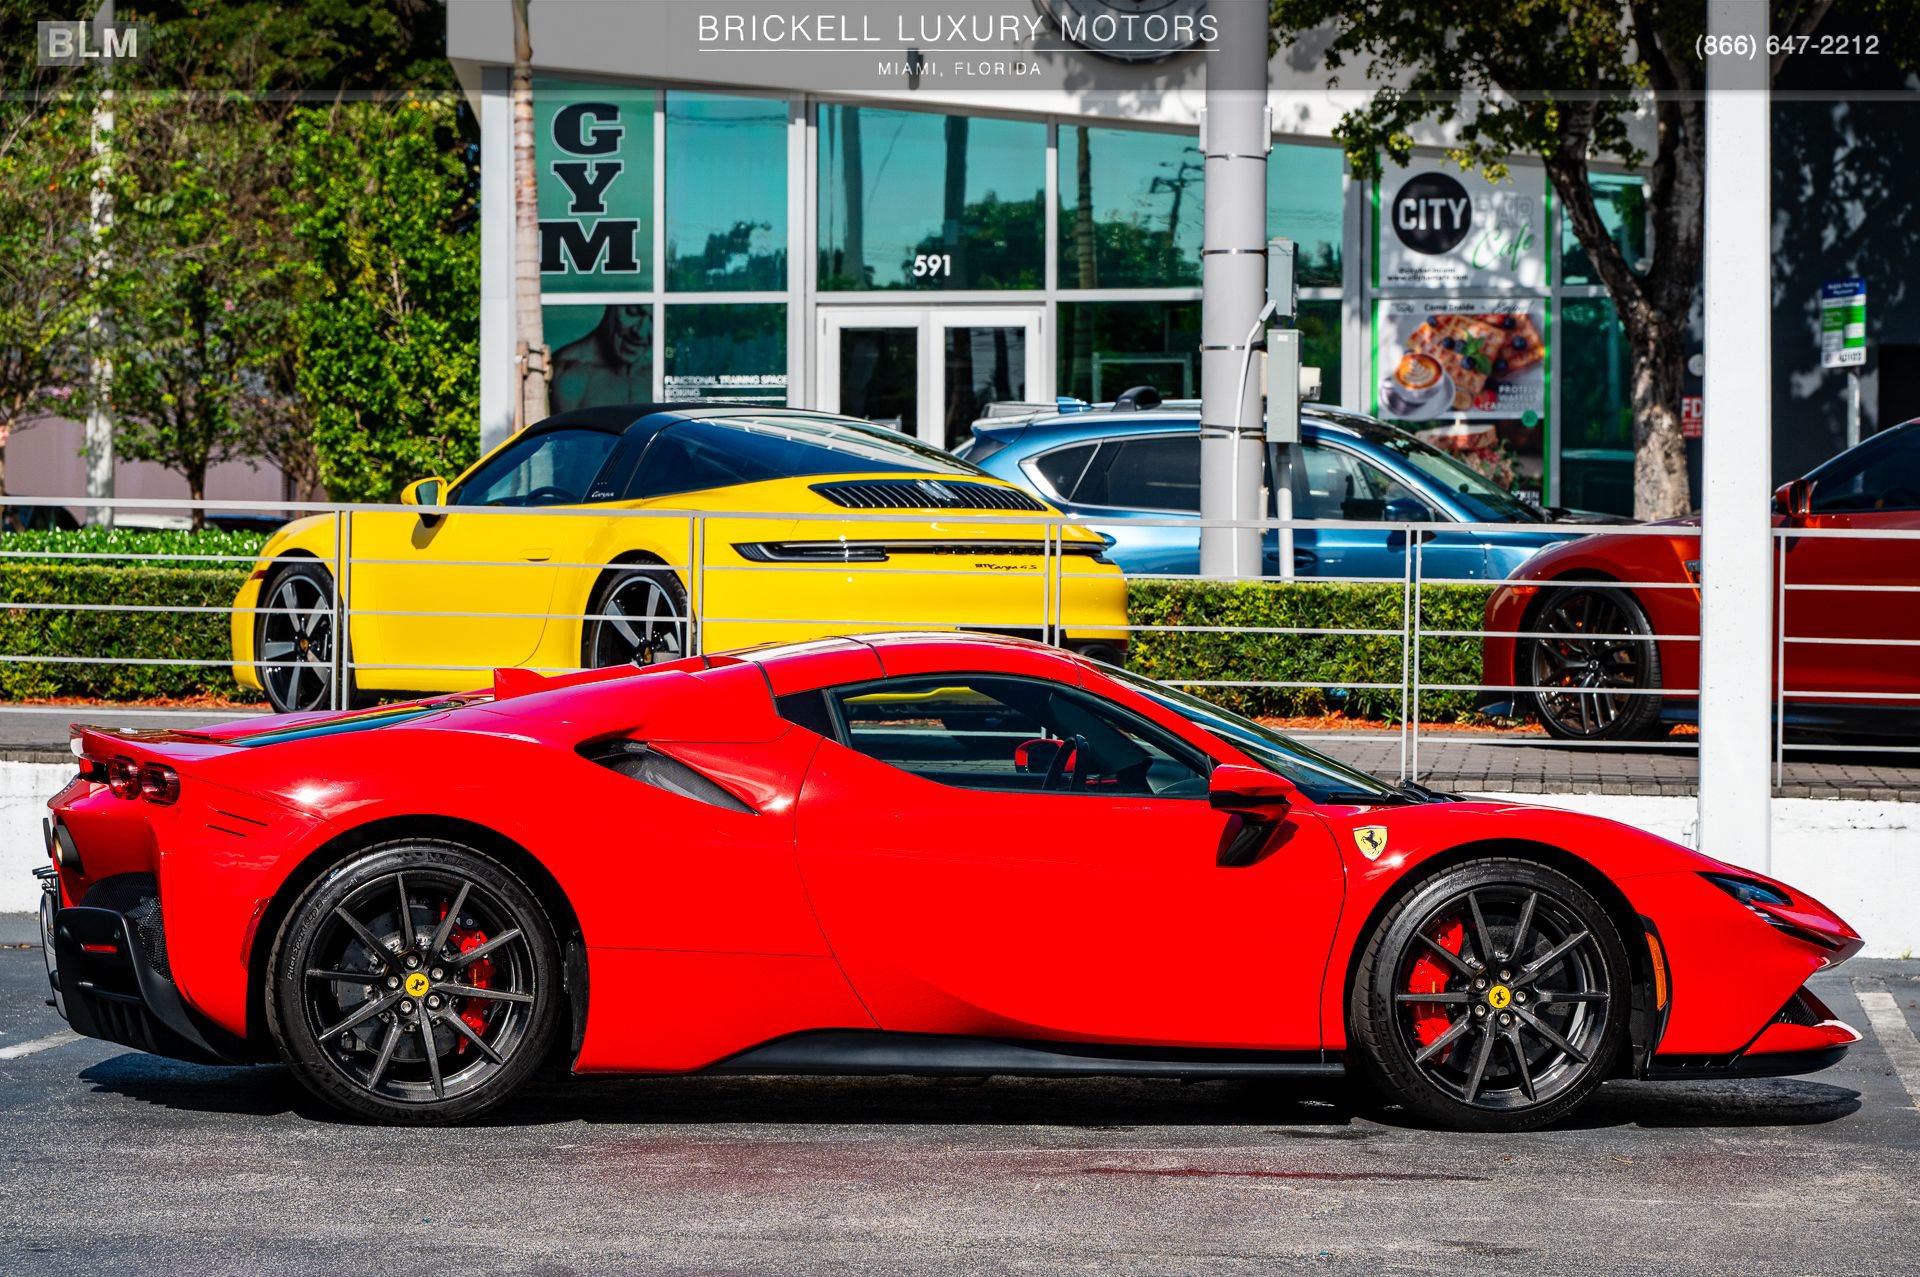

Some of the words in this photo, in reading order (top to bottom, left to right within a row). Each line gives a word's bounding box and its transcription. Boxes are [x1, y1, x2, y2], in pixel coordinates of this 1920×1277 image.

[539, 102, 641, 275] GYM
[1399, 198, 1468, 230] CITY
[912, 254, 951, 277] 591
[719, 374, 760, 385] TRAINING
[286, 956, 297, 981] Pilot
[292, 926, 309, 955] Sport
